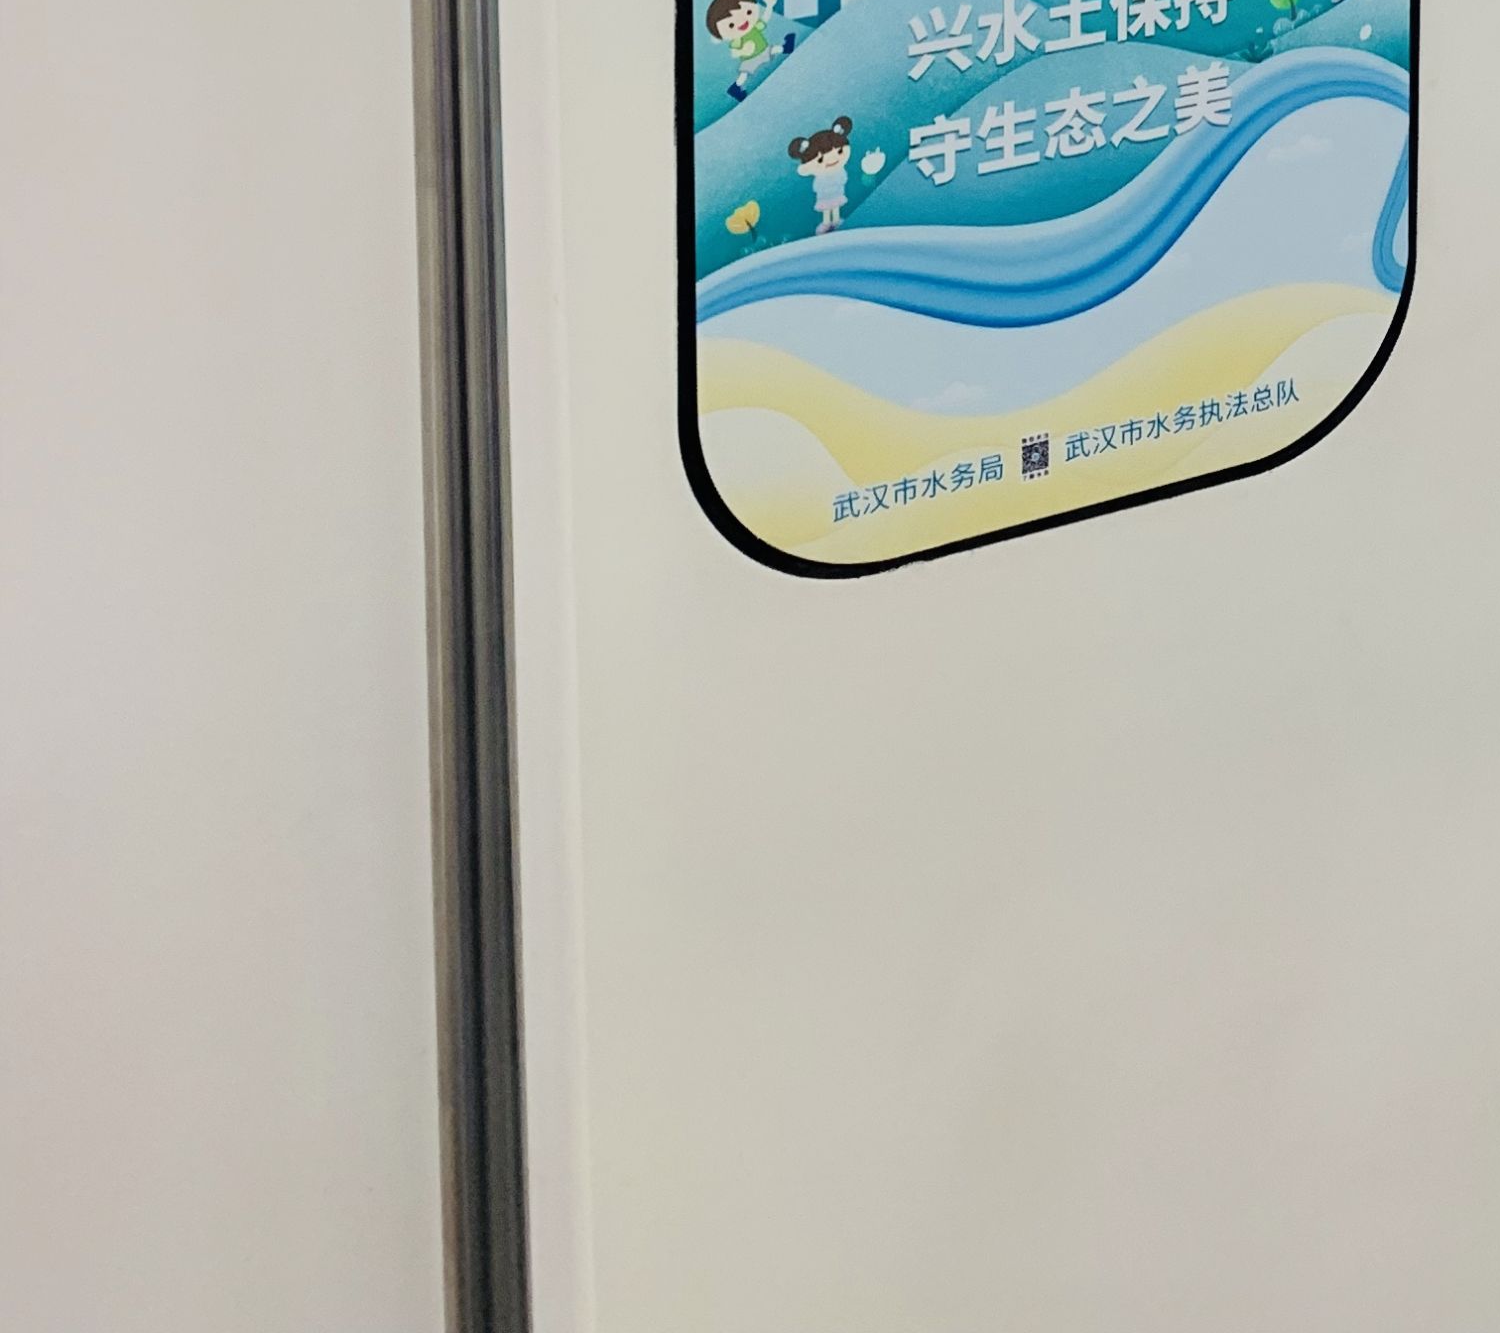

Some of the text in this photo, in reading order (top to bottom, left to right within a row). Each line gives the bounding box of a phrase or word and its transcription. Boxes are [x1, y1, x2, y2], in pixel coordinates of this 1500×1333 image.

[907, 61, 1234, 188] 守生态之美
[1063, 377, 1300, 464] 武汉市水务执法总队
[831, 454, 1003, 524] 武汉市水务局
